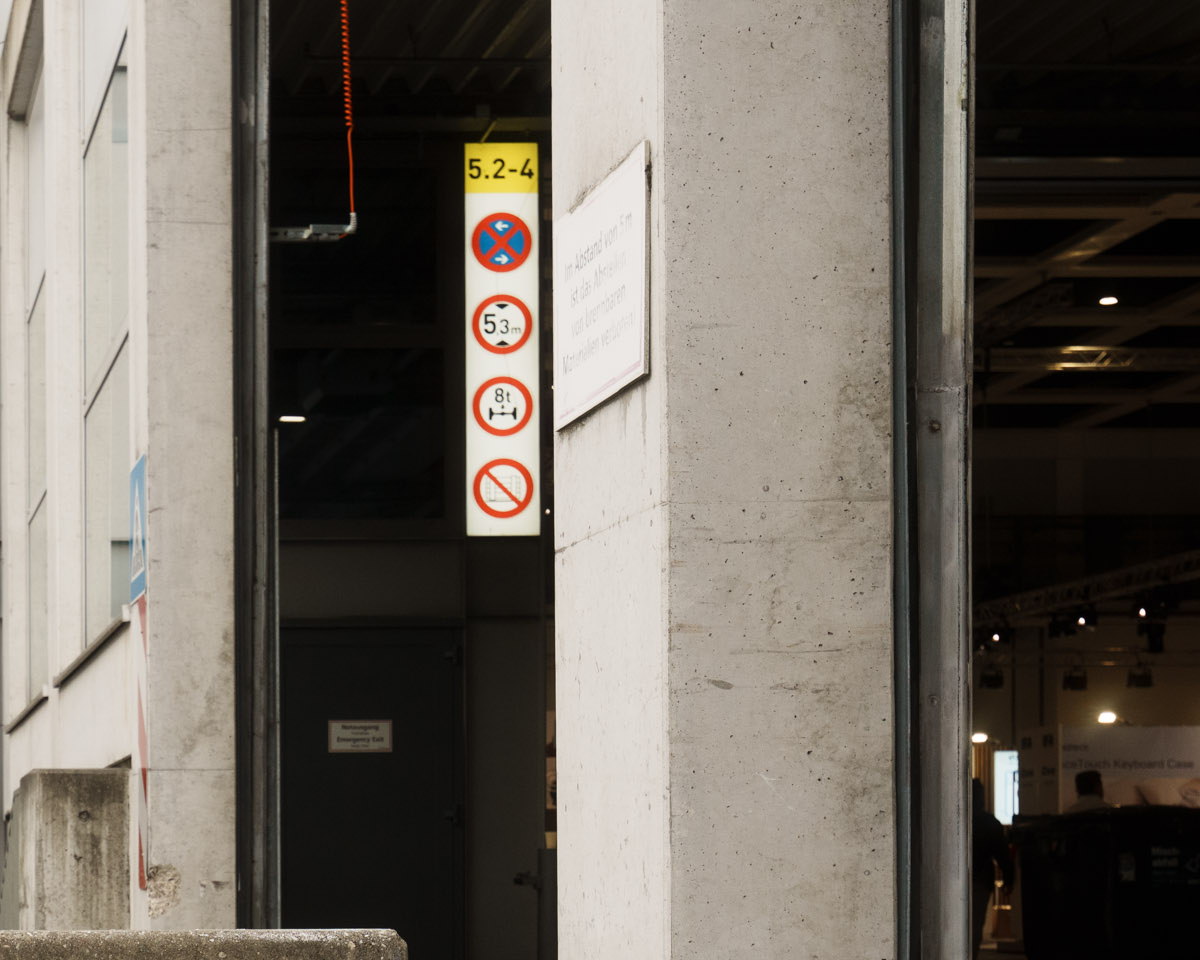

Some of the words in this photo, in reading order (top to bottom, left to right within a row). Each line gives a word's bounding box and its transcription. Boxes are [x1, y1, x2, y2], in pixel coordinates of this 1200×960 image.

[468, 158, 534, 179] 5.2-4
[575, 230, 603, 273] Abstand
[604, 224, 618, 248] von
[1167, 758, 1195, 769] Case
